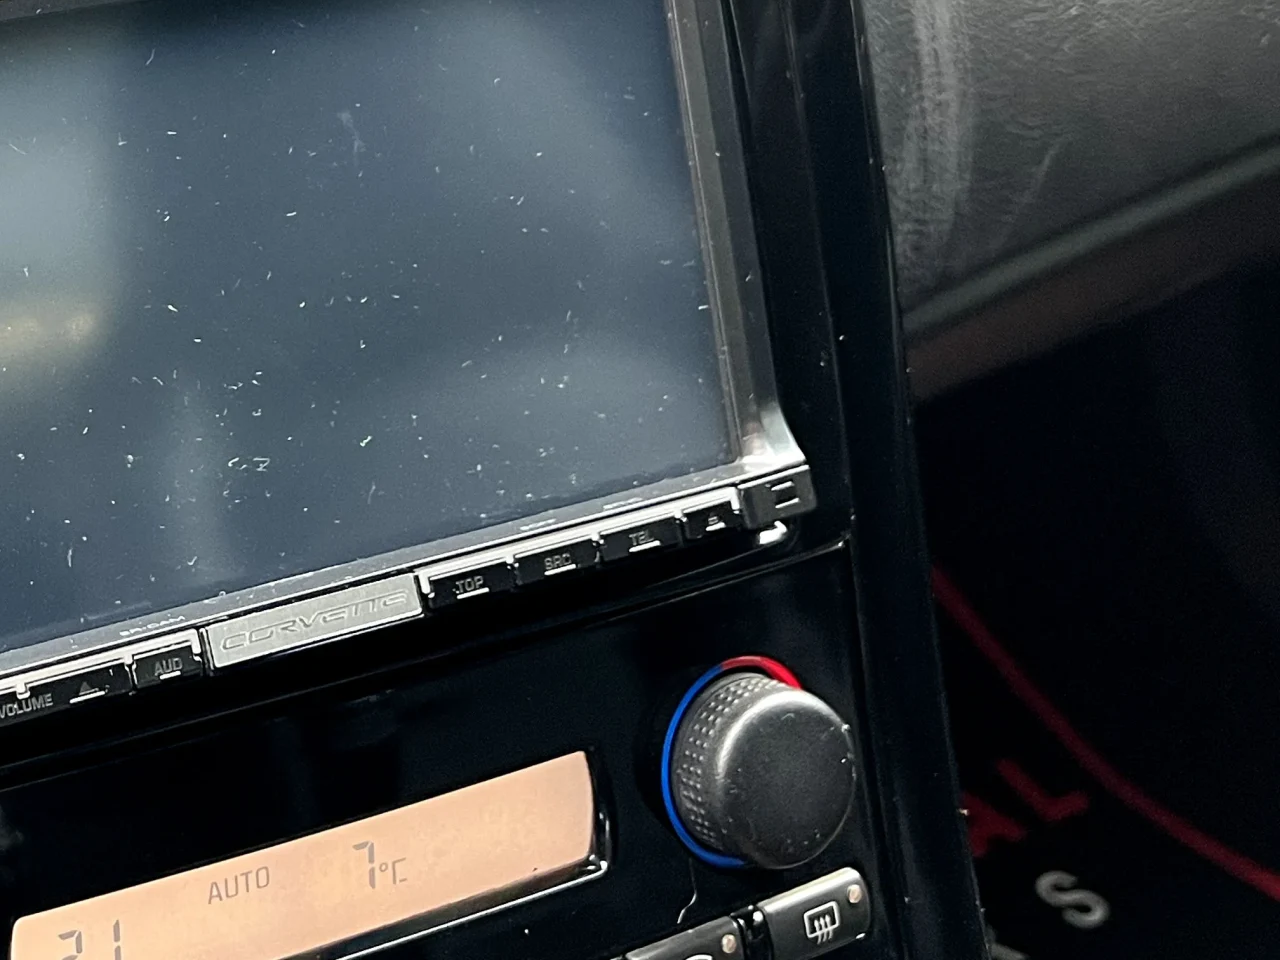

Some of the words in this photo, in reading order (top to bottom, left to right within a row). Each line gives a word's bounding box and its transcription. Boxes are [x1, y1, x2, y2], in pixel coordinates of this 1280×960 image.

[455, 575, 485, 594] TOP
[154, 657, 183, 677] AUD
[207, 865, 270, 905] AUTO
